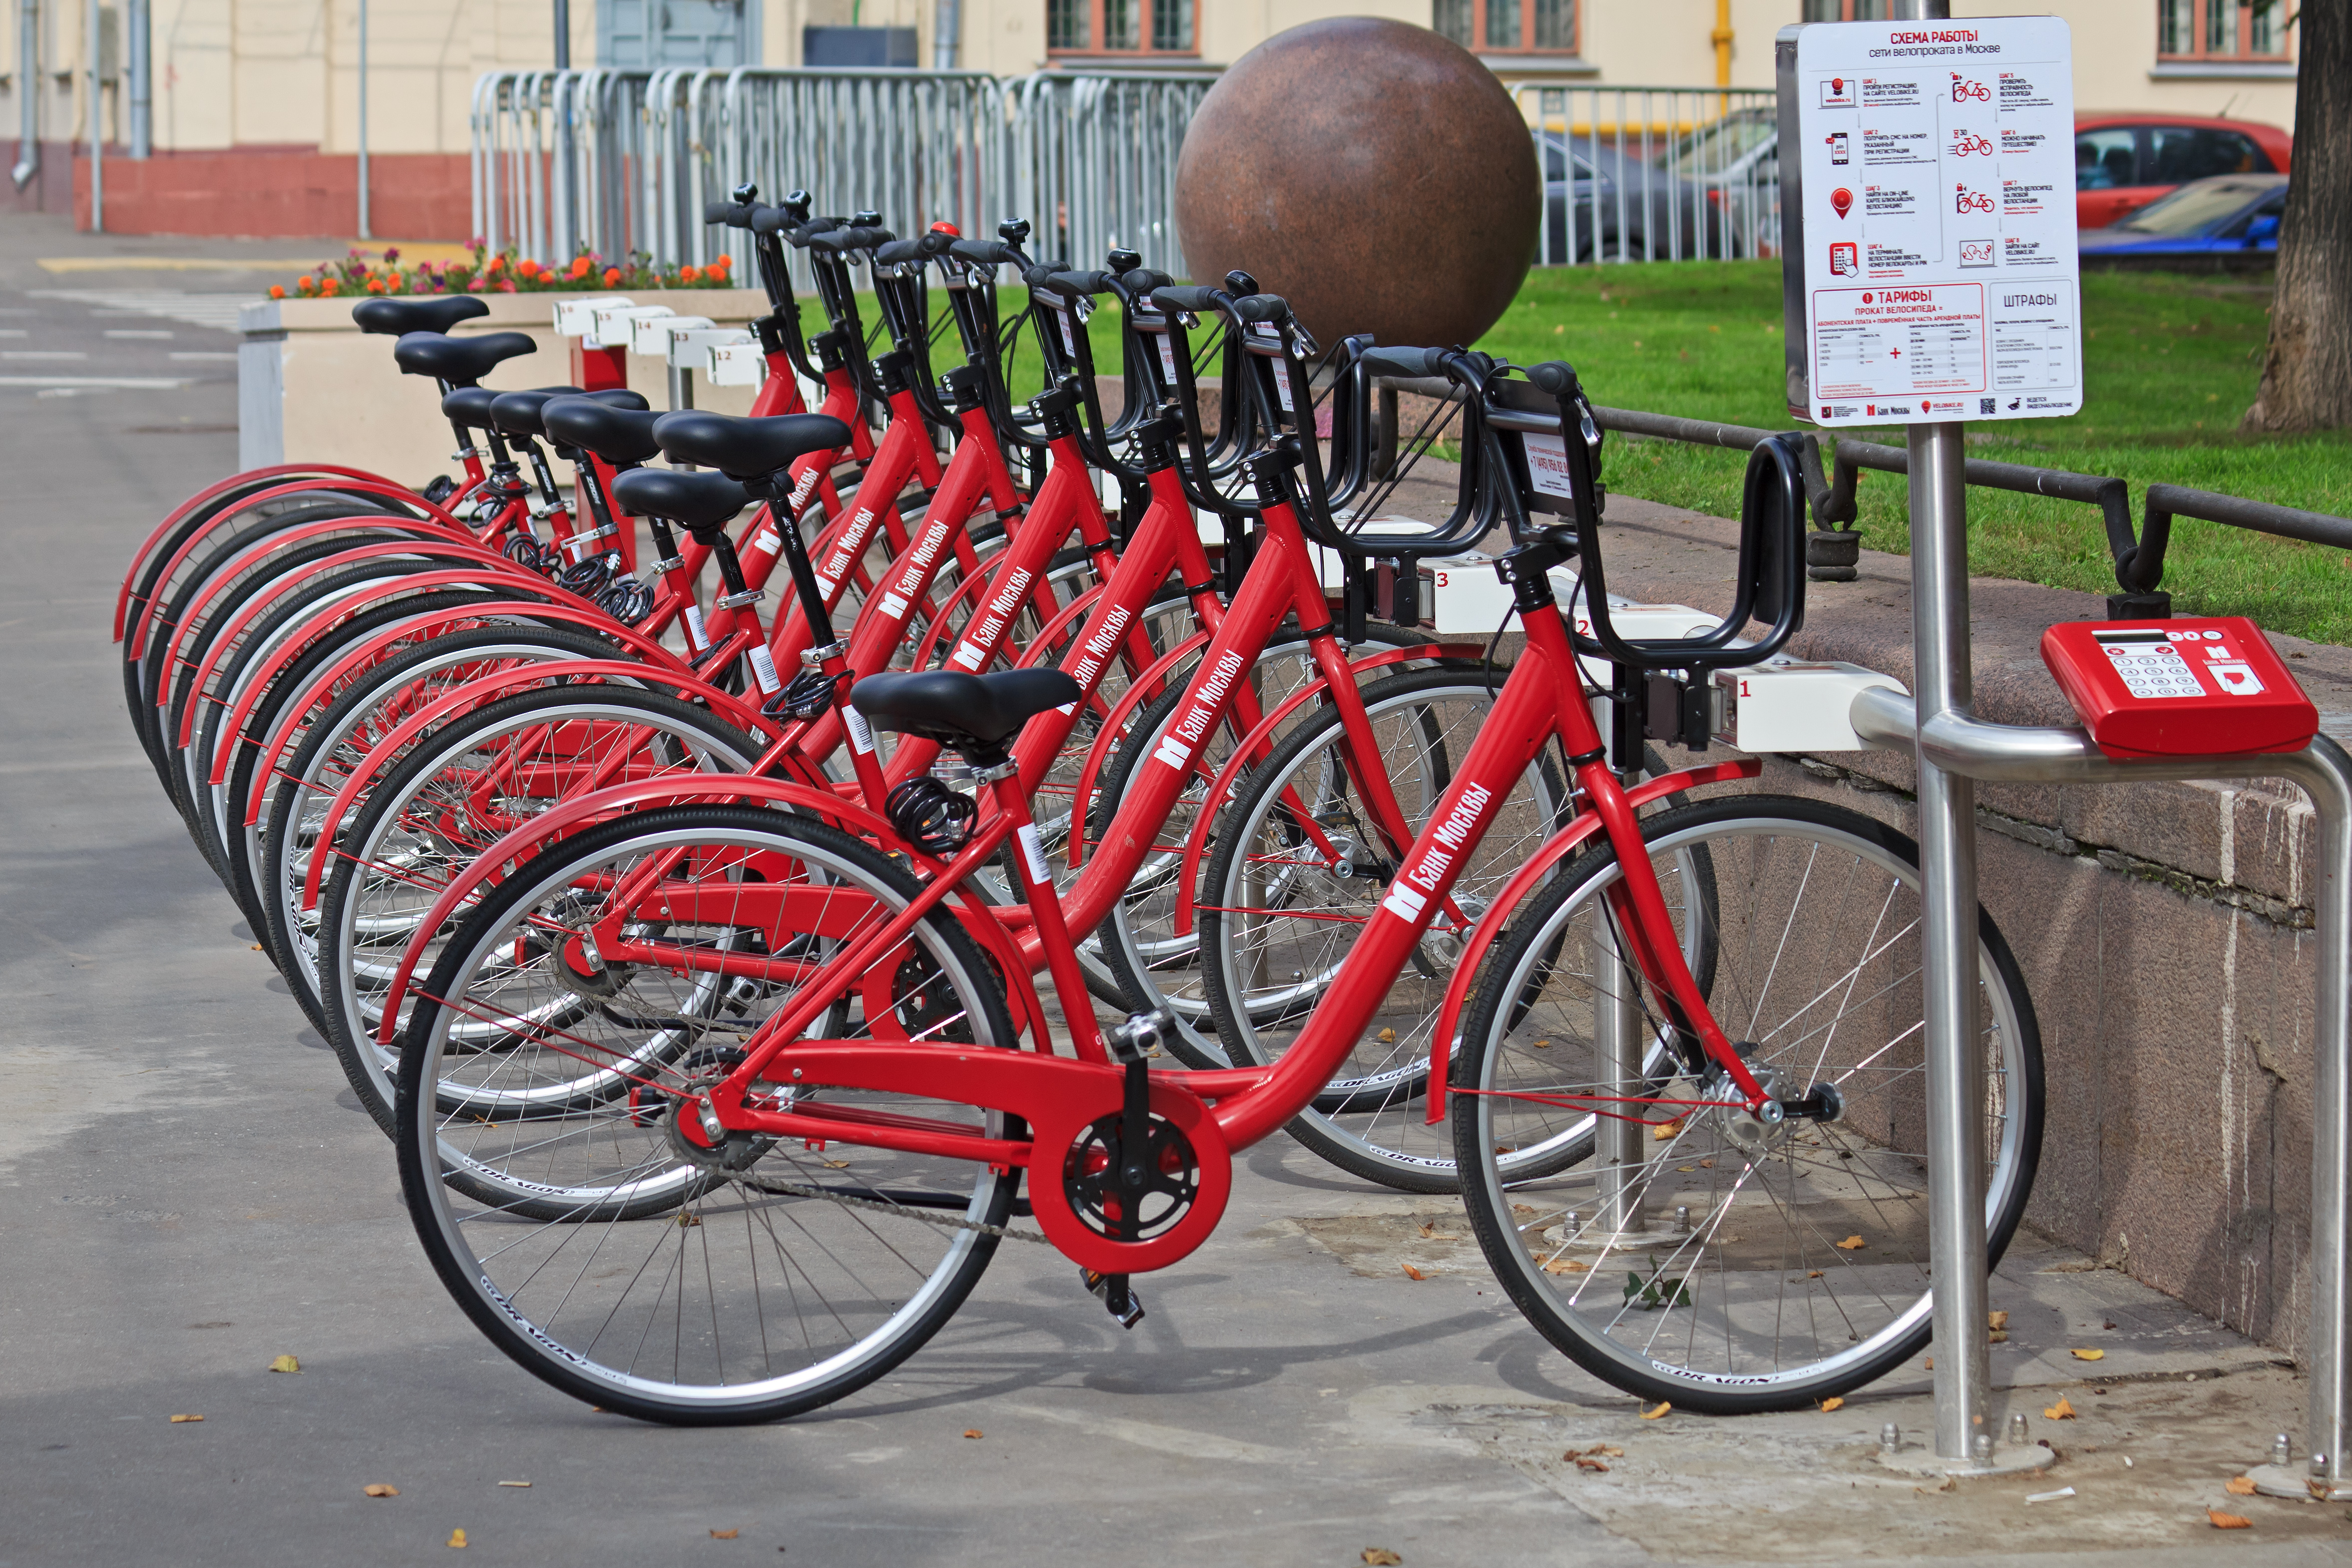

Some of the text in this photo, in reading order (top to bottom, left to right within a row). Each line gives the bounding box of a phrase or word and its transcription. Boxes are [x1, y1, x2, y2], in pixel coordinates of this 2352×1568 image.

[1891, 30, 1978, 44] СХЕМА РАБОТЫ
[1869, 49, 1891, 57] сети
[1893, 46, 1955, 57] велопроката
[1965, 44, 2001, 54] Москве
[1878, 290, 1932, 304] ТАРИФЫ
[2004, 293, 2057, 307] ШТРАФЫ
[1855, 307, 1884, 316] ПРОКАТ
[1886, 305, 1936, 314] ВЕЛОСИПЕДА
[674, 333, 689, 341] 13
[717, 351, 731, 361] 12
[1877, 405, 1911, 416] Банк Москвы
[538, 465, 554, 493] ZOOM
[788, 466, 819, 510] Москвы
[586, 475, 601, 505] ZOOM
[823, 506, 875, 580] Банк Москвы
[895, 519, 949, 597] Банк Москвы
[1437, 572, 1448, 587] 3
[972, 566, 1032, 648] Банк Москвы
[1085, 604, 1131, 659] Москвы
[1577, 620, 1589, 636] 2
[1176, 649, 1244, 743] Банк Москвы
[1740, 680, 1751, 697] 1
[1408, 781, 1492, 892] Банк Москвы
[289, 867, 306, 949] DRAGON
[1342, 1062, 1422, 1087] DRAGON
[1388, 1154, 1457, 1167] DRAGO
[480, 1169, 570, 1195] DRAGON
[494, 1297, 581, 1362] DRAGON
[1673, 1370, 1773, 1385] DRAGON
